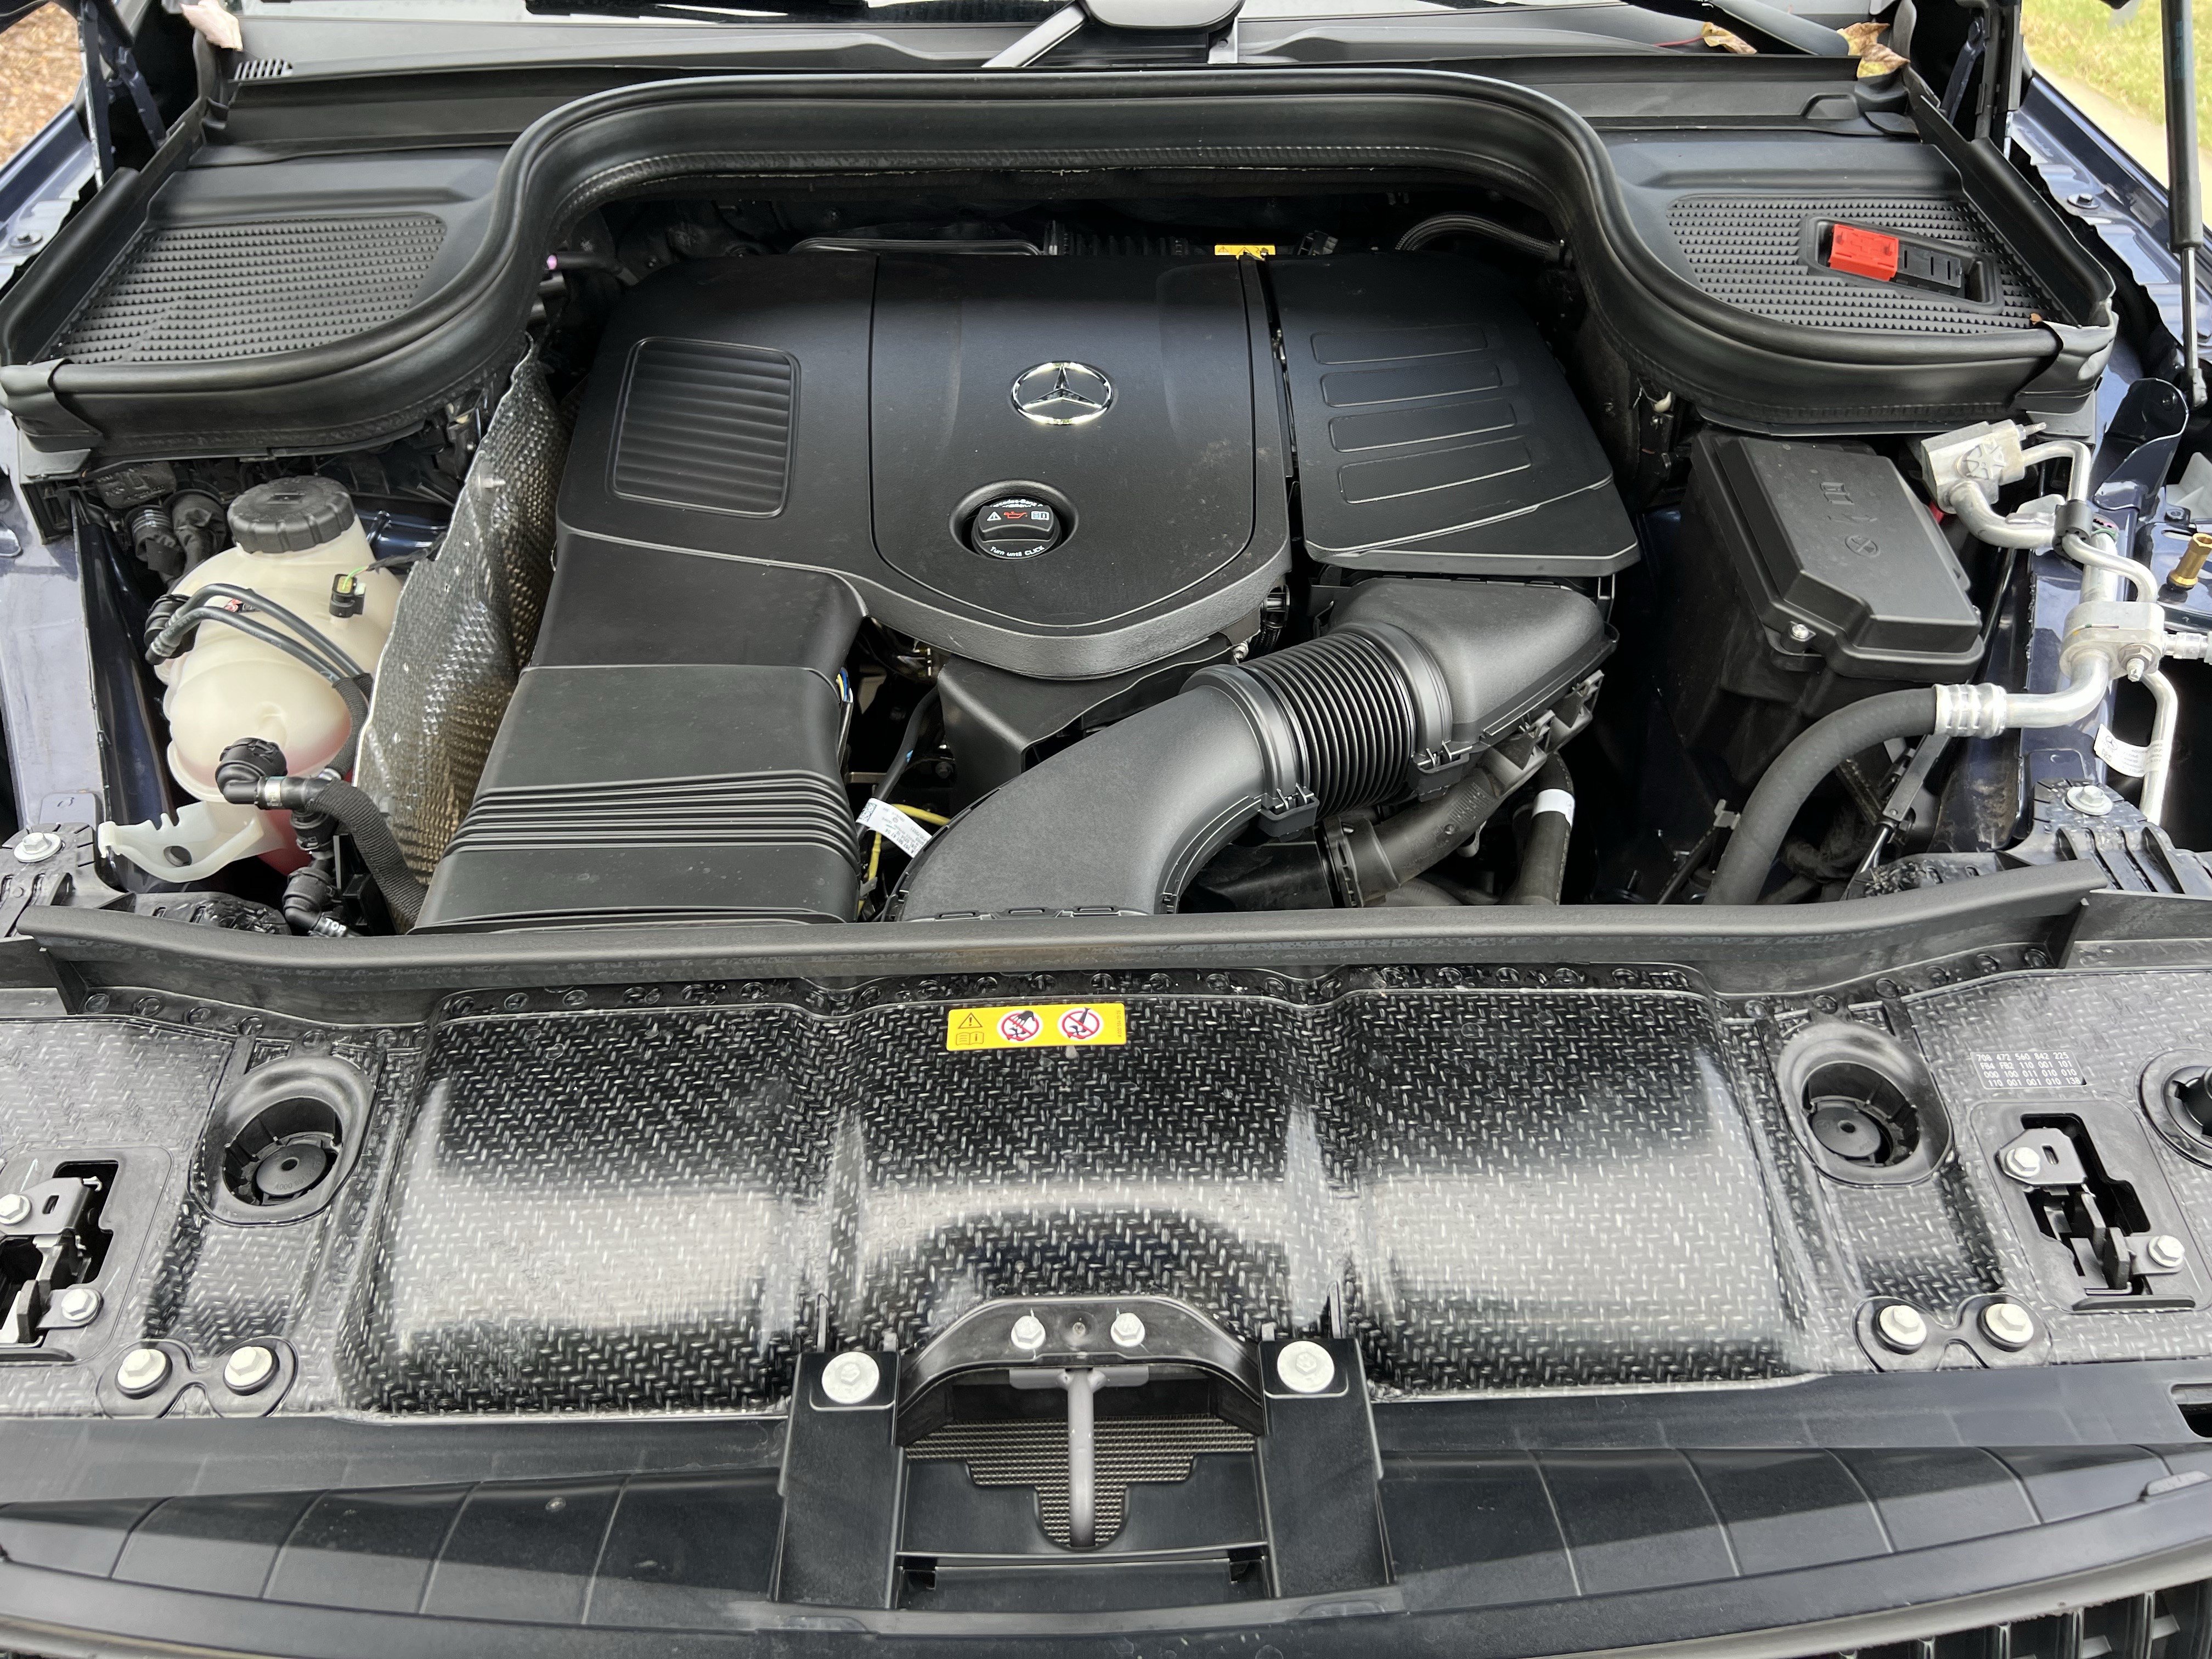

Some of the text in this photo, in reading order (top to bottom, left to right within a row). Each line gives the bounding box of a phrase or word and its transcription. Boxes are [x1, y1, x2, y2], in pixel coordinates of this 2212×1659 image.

[990, 546, 1005, 555] Turn
[1024, 545, 1045, 556] CLICK
[325, 917, 347, 933] TOP
[2038, 1060, 2053, 1069] 001
